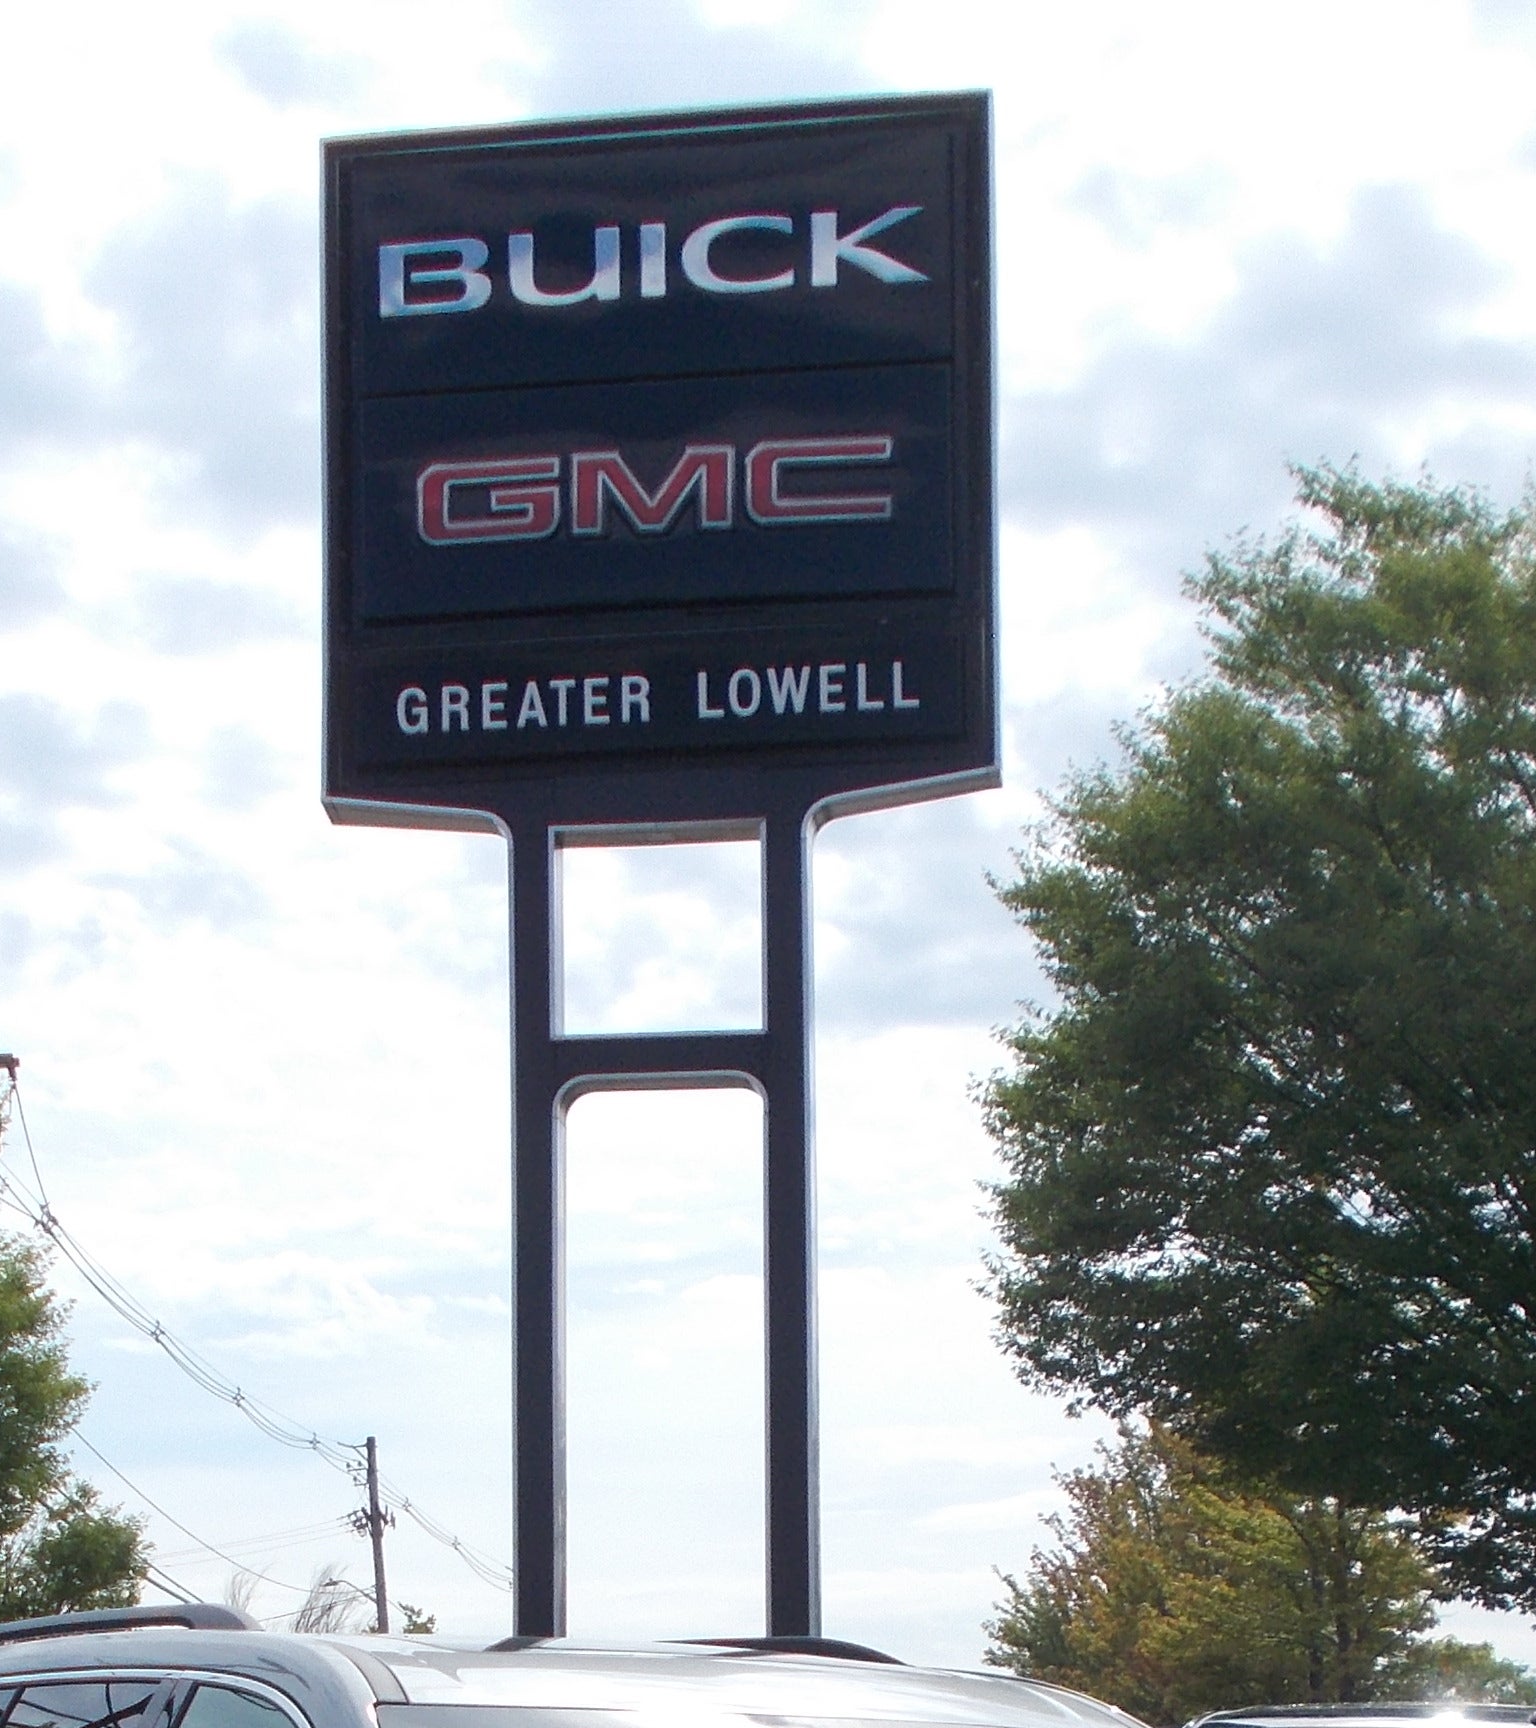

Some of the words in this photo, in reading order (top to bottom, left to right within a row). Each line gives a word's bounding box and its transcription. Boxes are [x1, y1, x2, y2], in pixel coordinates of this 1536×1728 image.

[378, 205, 932, 318] BUICK
[416, 436, 892, 546] GMC
[396, 673, 651, 735] GREATER
[697, 661, 920, 720] LOWELL
